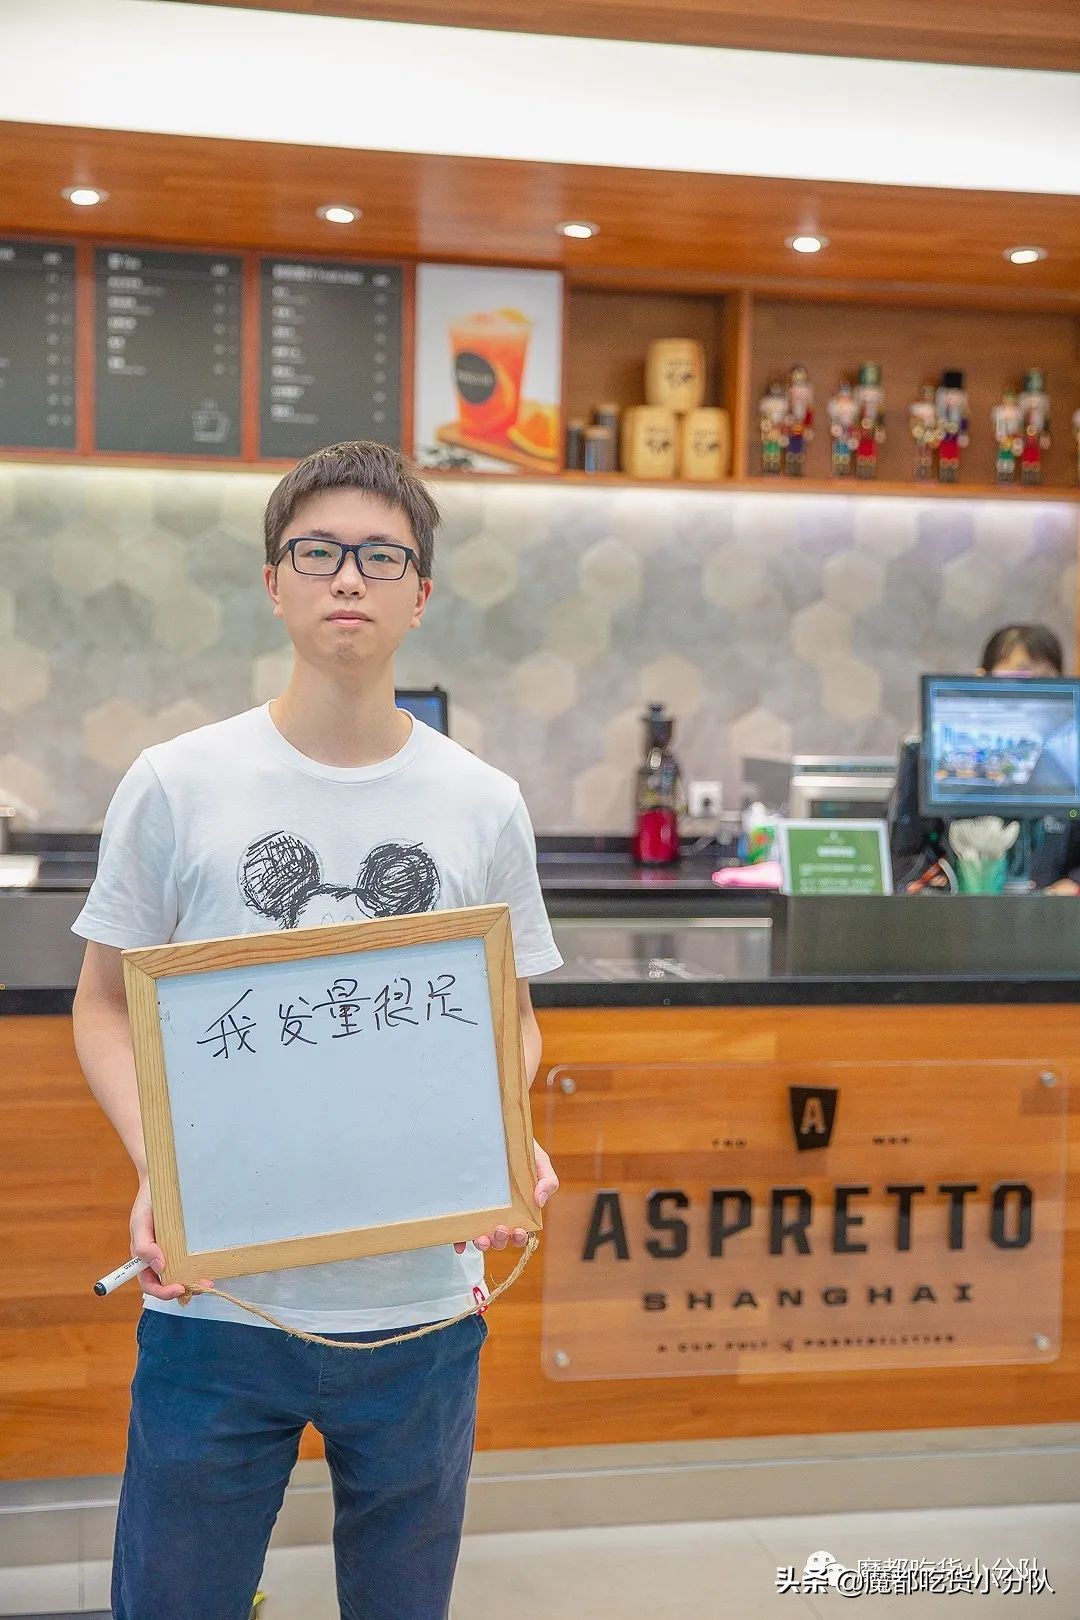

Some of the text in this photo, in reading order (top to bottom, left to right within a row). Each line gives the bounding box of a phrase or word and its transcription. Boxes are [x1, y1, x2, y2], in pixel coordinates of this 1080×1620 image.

[197, 974, 478, 1059] 我发量很足
[801, 1097, 827, 1135] A
[582, 1182, 1034, 1262] ASPRETTO
[643, 1283, 974, 1311] SHANGHAI
